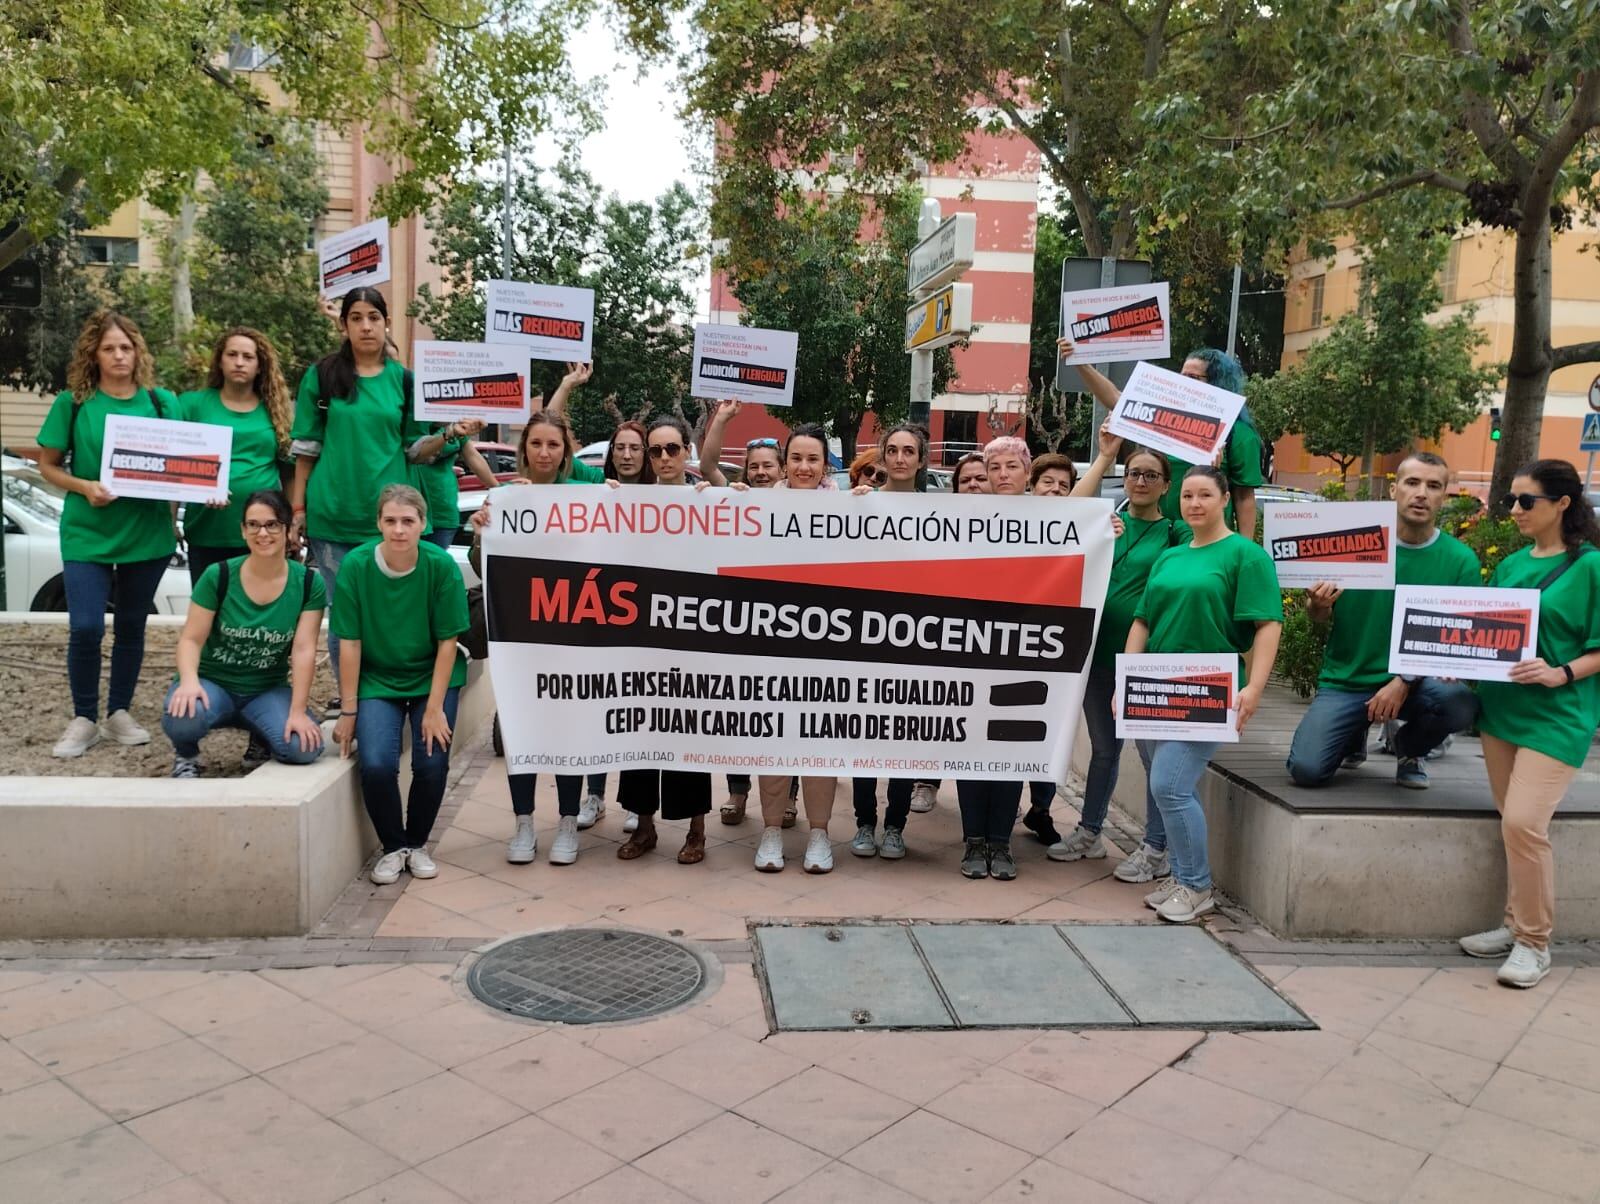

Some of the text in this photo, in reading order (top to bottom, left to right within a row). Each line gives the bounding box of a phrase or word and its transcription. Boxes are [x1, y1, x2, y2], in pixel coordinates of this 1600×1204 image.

[495, 311, 582, 339] MÁS RECURSOS
[1072, 321, 1089, 338] NO
[1088, 316, 1110, 336] SON
[1110, 304, 1160, 330] NÚMEROS
[701, 363, 785, 383] AUDICIÓN Y LENGUAJE
[424, 380, 520, 398] NO ESTÁN SEGUROS
[1123, 400, 1217, 438] AÑOS LUCHANDO
[111, 453, 166, 472] RECURSOS
[166, 458, 217, 477] HUMANOS
[501, 497, 1080, 545] NO ABANDONÉIS LA EDUCACIÓN PÚBLICA
[1273, 532, 1383, 559] SER ESCUCHADOS
[530, 568, 1065, 659] MÁS RECURSOS DOCENTES
[1405, 597, 1520, 608] ALGUNAS INFRAESTRUCTURAS
[1407, 614, 1473, 630] PONEN EN PELIGRO
[1403, 640, 1499, 659] DE NUESTROS HIJOS E HIJAS
[1440, 627, 1521, 651] LA SALUD
[1171, 665, 1184, 673] QUE
[537, 667, 974, 707] POR UNA ENSEÑANZA DE CALIDAD E IGUALDAD
[1141, 683, 1175, 694] CONFORMO
[1175, 684, 1188, 695] CON
[1127, 693, 1146, 704] FINAL
[1145, 694, 1157, 705] DEL
[1157, 693, 1168, 705] DÍA
[1127, 706, 1136, 716] SE
[605, 707, 967, 743] CEIP JUAN CARLOS I LLANO DE BRUJAS
[555, 756, 568, 766] DE
[569, 754, 613, 767] CALIDAD
[615, 753, 621, 762] E
[622, 751, 675, 763] IGUALDAD
[683, 752, 705, 764] #NO
[707, 753, 774, 767] ABANDONÉIS
[776, 756, 784, 767] A
[786, 756, 799, 767] LA
[801, 754, 846, 769] PÚBLICA
[852, 756, 883, 770] #MÁS
[884, 759, 940, 771] RECURSOS
[943, 760, 972, 772] PARA
[974, 761, 986, 772] EL
[988, 761, 1011, 773] CEIP
[1014, 762, 1040, 773] JUAN
[1042, 763, 1049, 774] C
